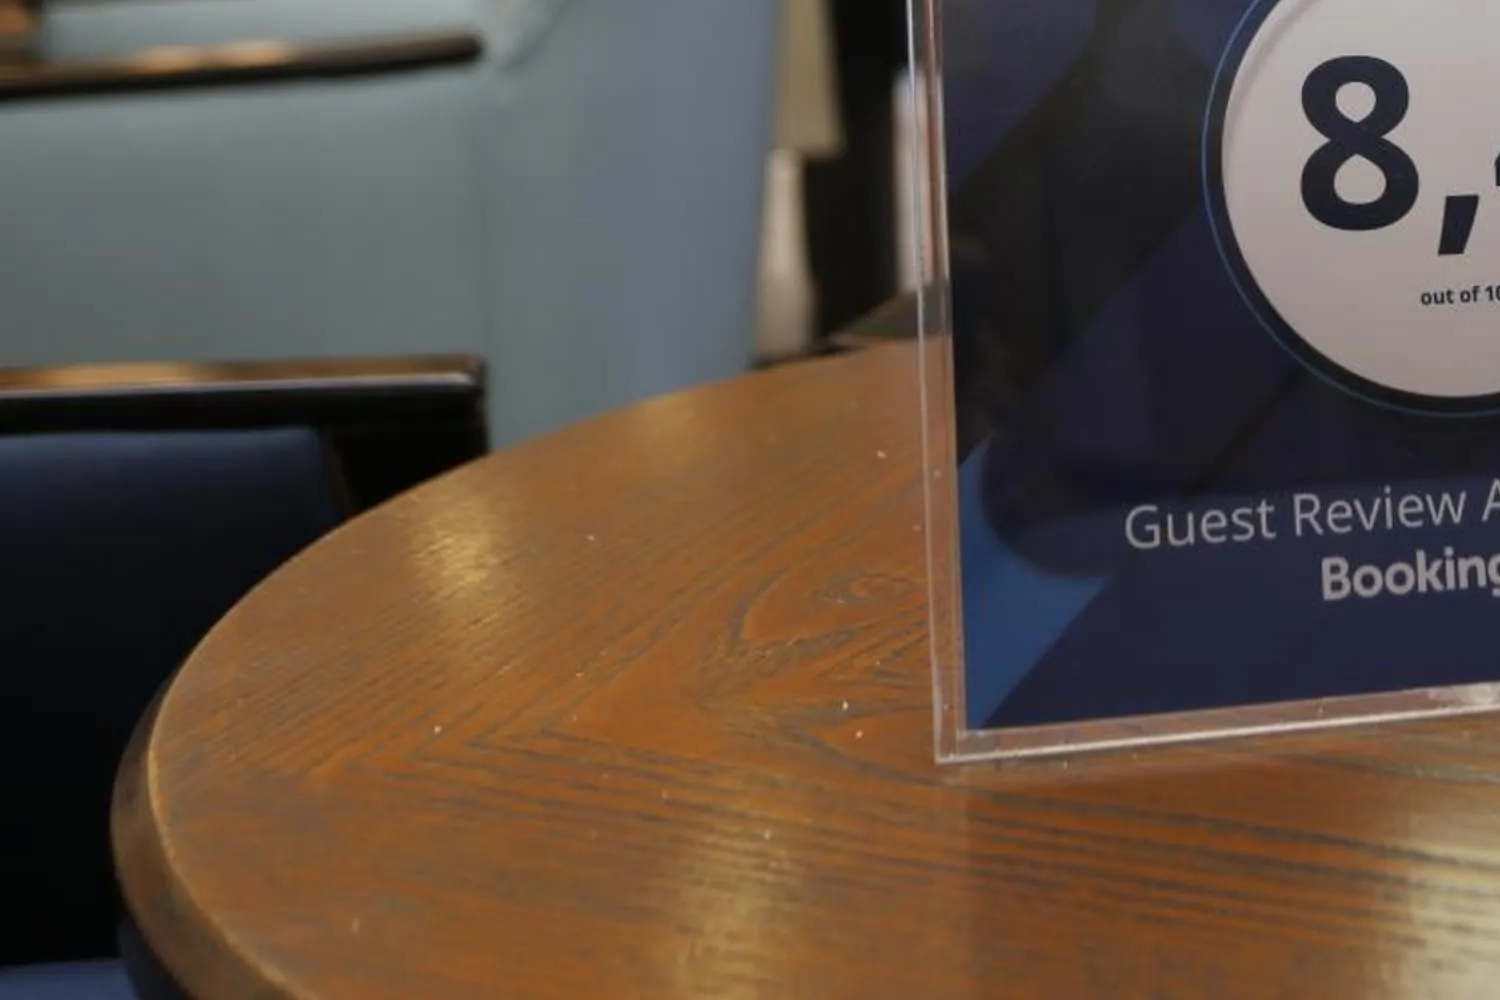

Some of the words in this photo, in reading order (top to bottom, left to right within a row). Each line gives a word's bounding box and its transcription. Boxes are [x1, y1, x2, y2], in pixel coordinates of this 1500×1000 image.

[1420, 287, 1454, 306] out
[1459, 284, 1482, 304] of
[1125, 502, 1276, 549] Guest
[1293, 486, 1467, 536] Review
